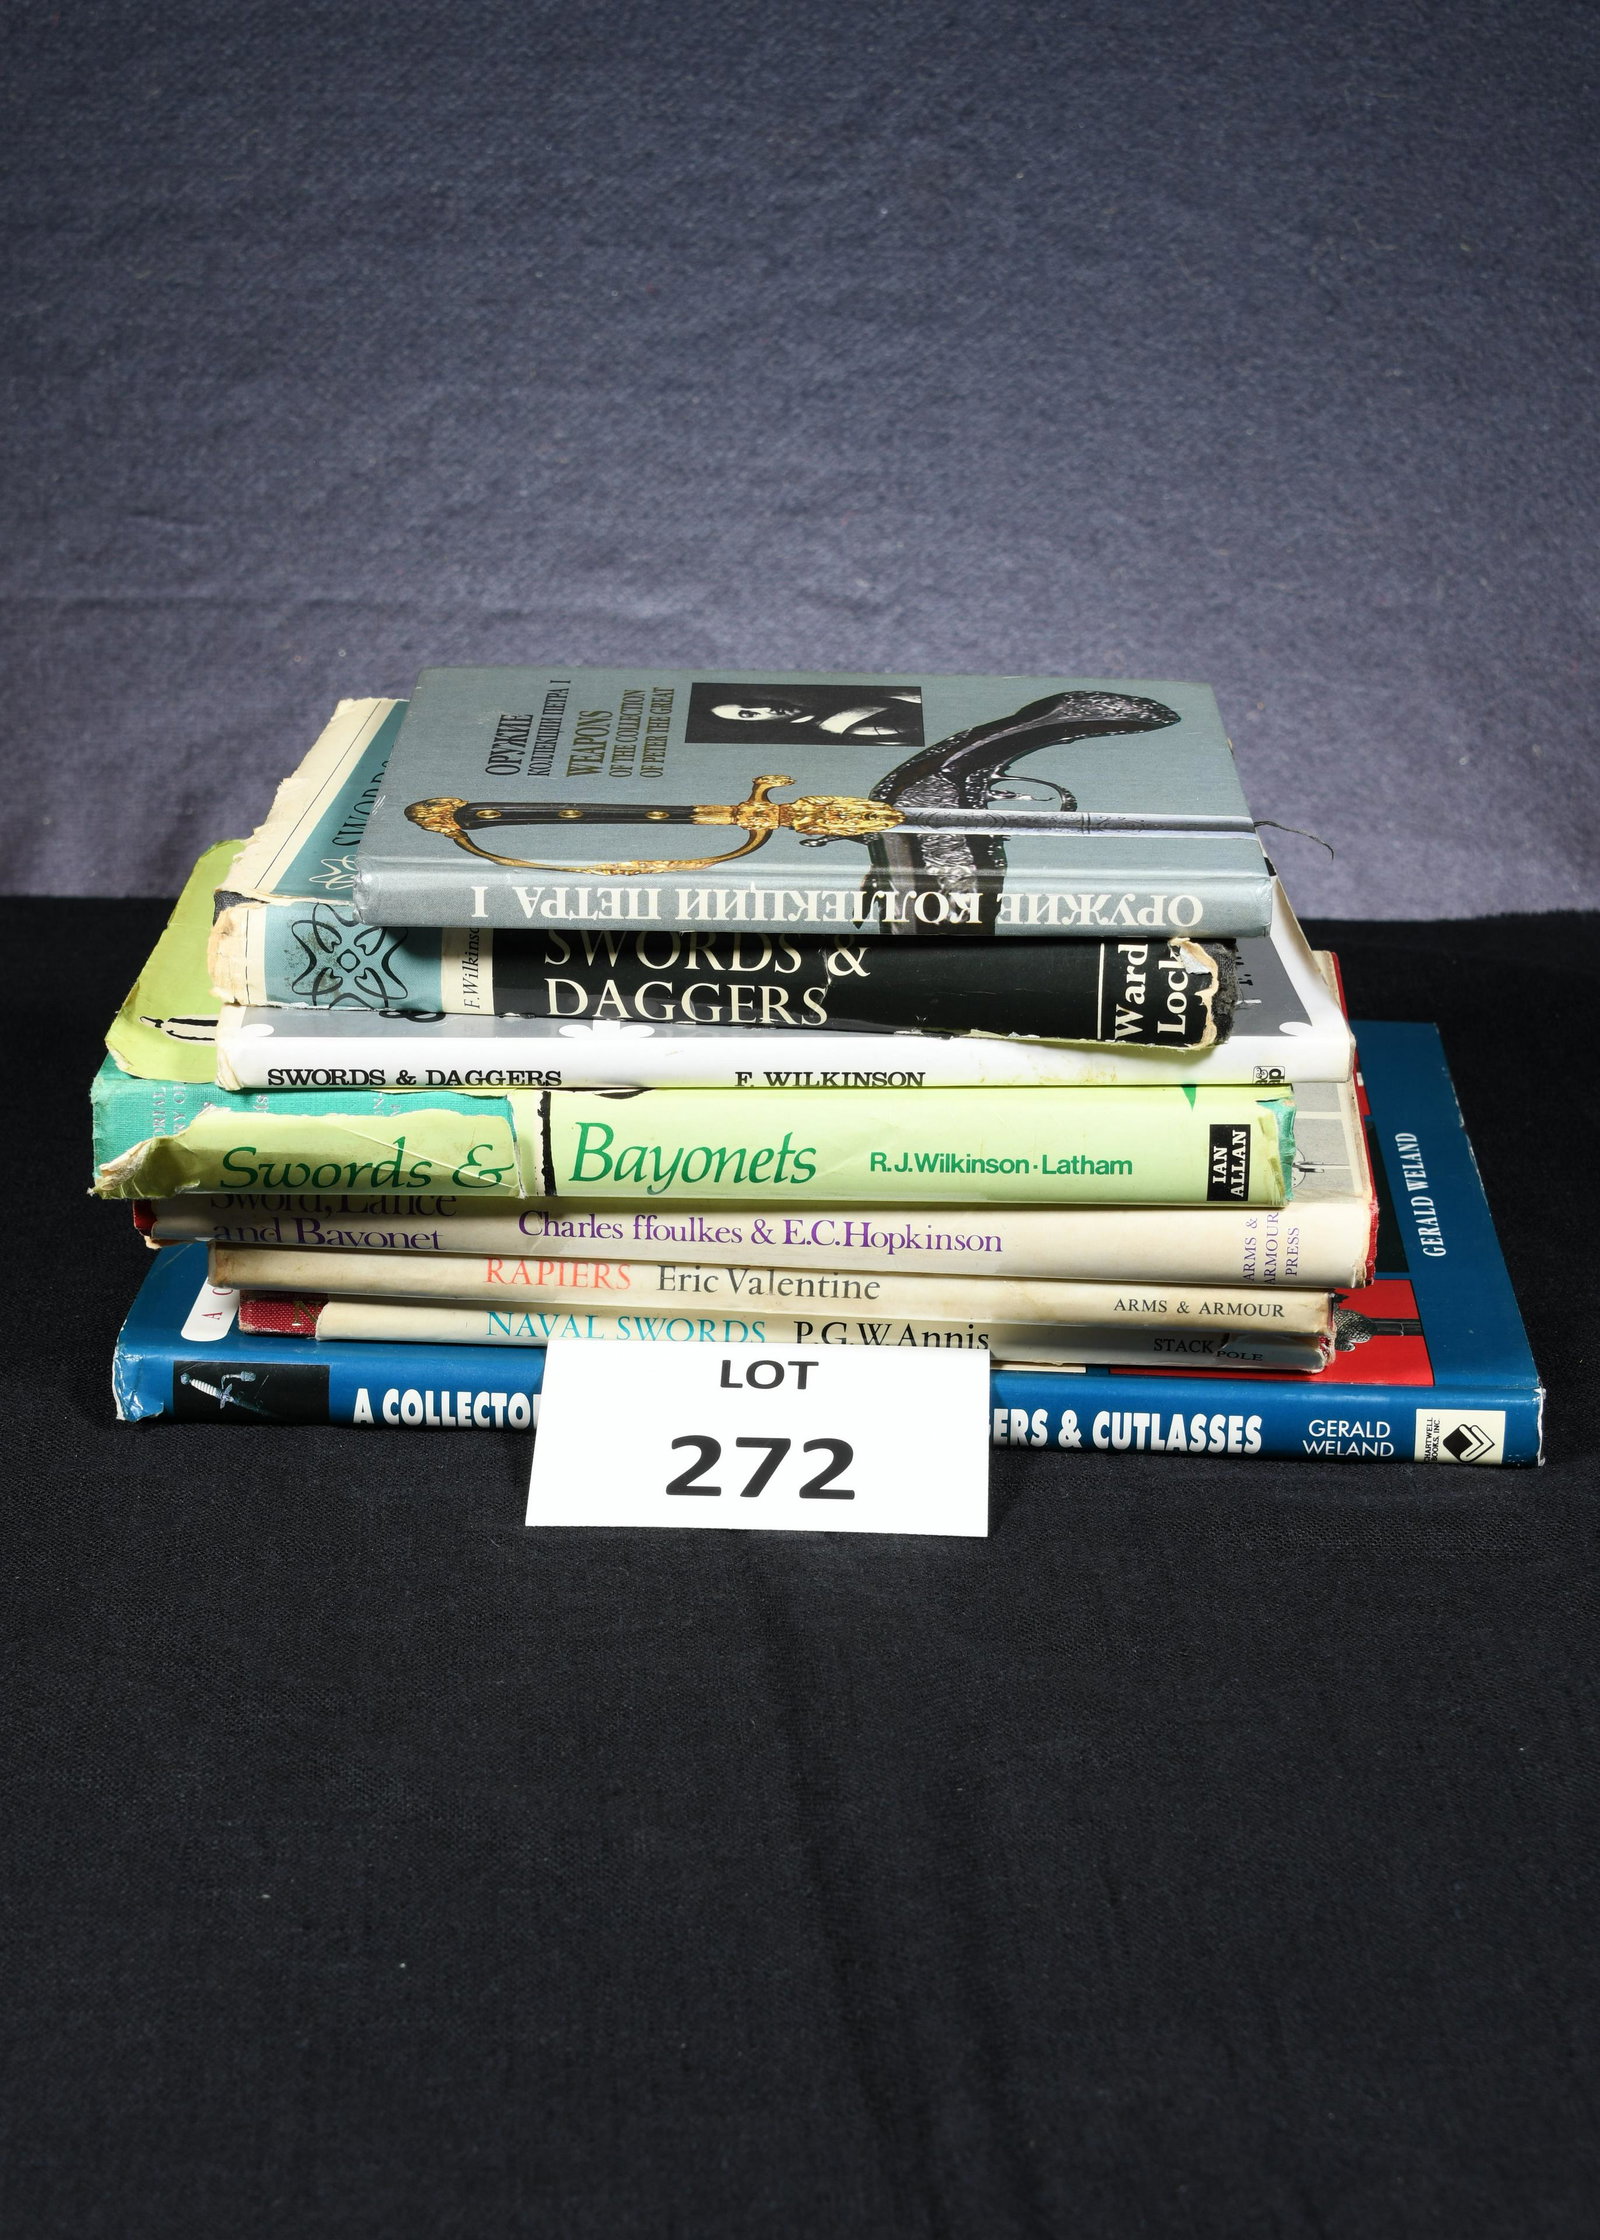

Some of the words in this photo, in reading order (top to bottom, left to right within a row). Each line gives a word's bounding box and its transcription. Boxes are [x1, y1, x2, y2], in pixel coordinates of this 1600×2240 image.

[542, 688, 570, 716] ПЕТРА
[615, 689, 646, 743] COLLECTION
[649, 686, 675, 715] GREAT
[566, 710, 613, 777] WEAPONS
[646, 716, 671, 733] THE
[485, 714, 534, 776] ОРУЖИЕ
[611, 744, 637, 764] THE
[641, 735, 668, 764] PETER
[608, 764, 633, 778] OF
[639, 765, 664, 778] OF
[512, 886, 661, 921] ПЕТРА
[675, 880, 984, 925] КОЛЛЕКЦИИ
[996, 892, 1204, 927] ОРУЖИЕ
[544, 930, 802, 973] SWORDS
[827, 934, 872, 977] &
[543, 978, 828, 1027] DAGGERS
[1114, 943, 1149, 1040] Ward
[1157, 950, 1188, 1036] Lock
[267, 1068, 386, 1086] SWORDS
[396, 1069, 417, 1086] &
[425, 1069, 562, 1087] DAGGERS
[734, 1071, 752, 1087] F.
[762, 1071, 926, 1088] WILKINSON
[220, 1136, 433, 1189] Swords
[452, 1144, 515, 1188] &
[569, 1122, 817, 1195] Bayonets
[1212, 1146, 1228, 1184] IAN
[1230, 1129, 1247, 1198] ALLAN
[1394, 1132, 1429, 1192] WELAND
[213, 1217, 285, 1243] and
[518, 1209, 624, 1241] Charles
[633, 1213, 743, 1245] ffoulkes
[750, 1218, 776, 1245] &
[1246, 1217, 1258, 1229] &
[1410, 1195, 1447, 1257] GERALD
[1243, 1237, 1257, 1282] ARMS
[1263, 1212, 1279, 1285] ARMOUR
[1285, 1227, 1299, 1277] PRESS
[487, 1257, 632, 1291] RAPIERS
[657, 1264, 719, 1294] Eric
[725, 1267, 881, 1301] Valentine
[1113, 1298, 1168, 1314] ARMS
[1176, 1301, 1191, 1315] &
[1198, 1301, 1285, 1318] ARMOUR
[487, 1311, 605, 1342] NAVAL
[616, 1315, 766, 1344] SWORDS
[720, 1359, 819, 1390] LOT
[353, 1388, 375, 1424] A
[382, 1388, 541, 1430] COLLECTO
[1057, 1410, 1082, 1448] &
[1092, 1411, 1263, 1454] CUTLASSES
[1308, 1419, 1391, 1439] GERALD
[666, 1434, 855, 1500] 272
[1302, 1440, 1394, 1457] WELAND
